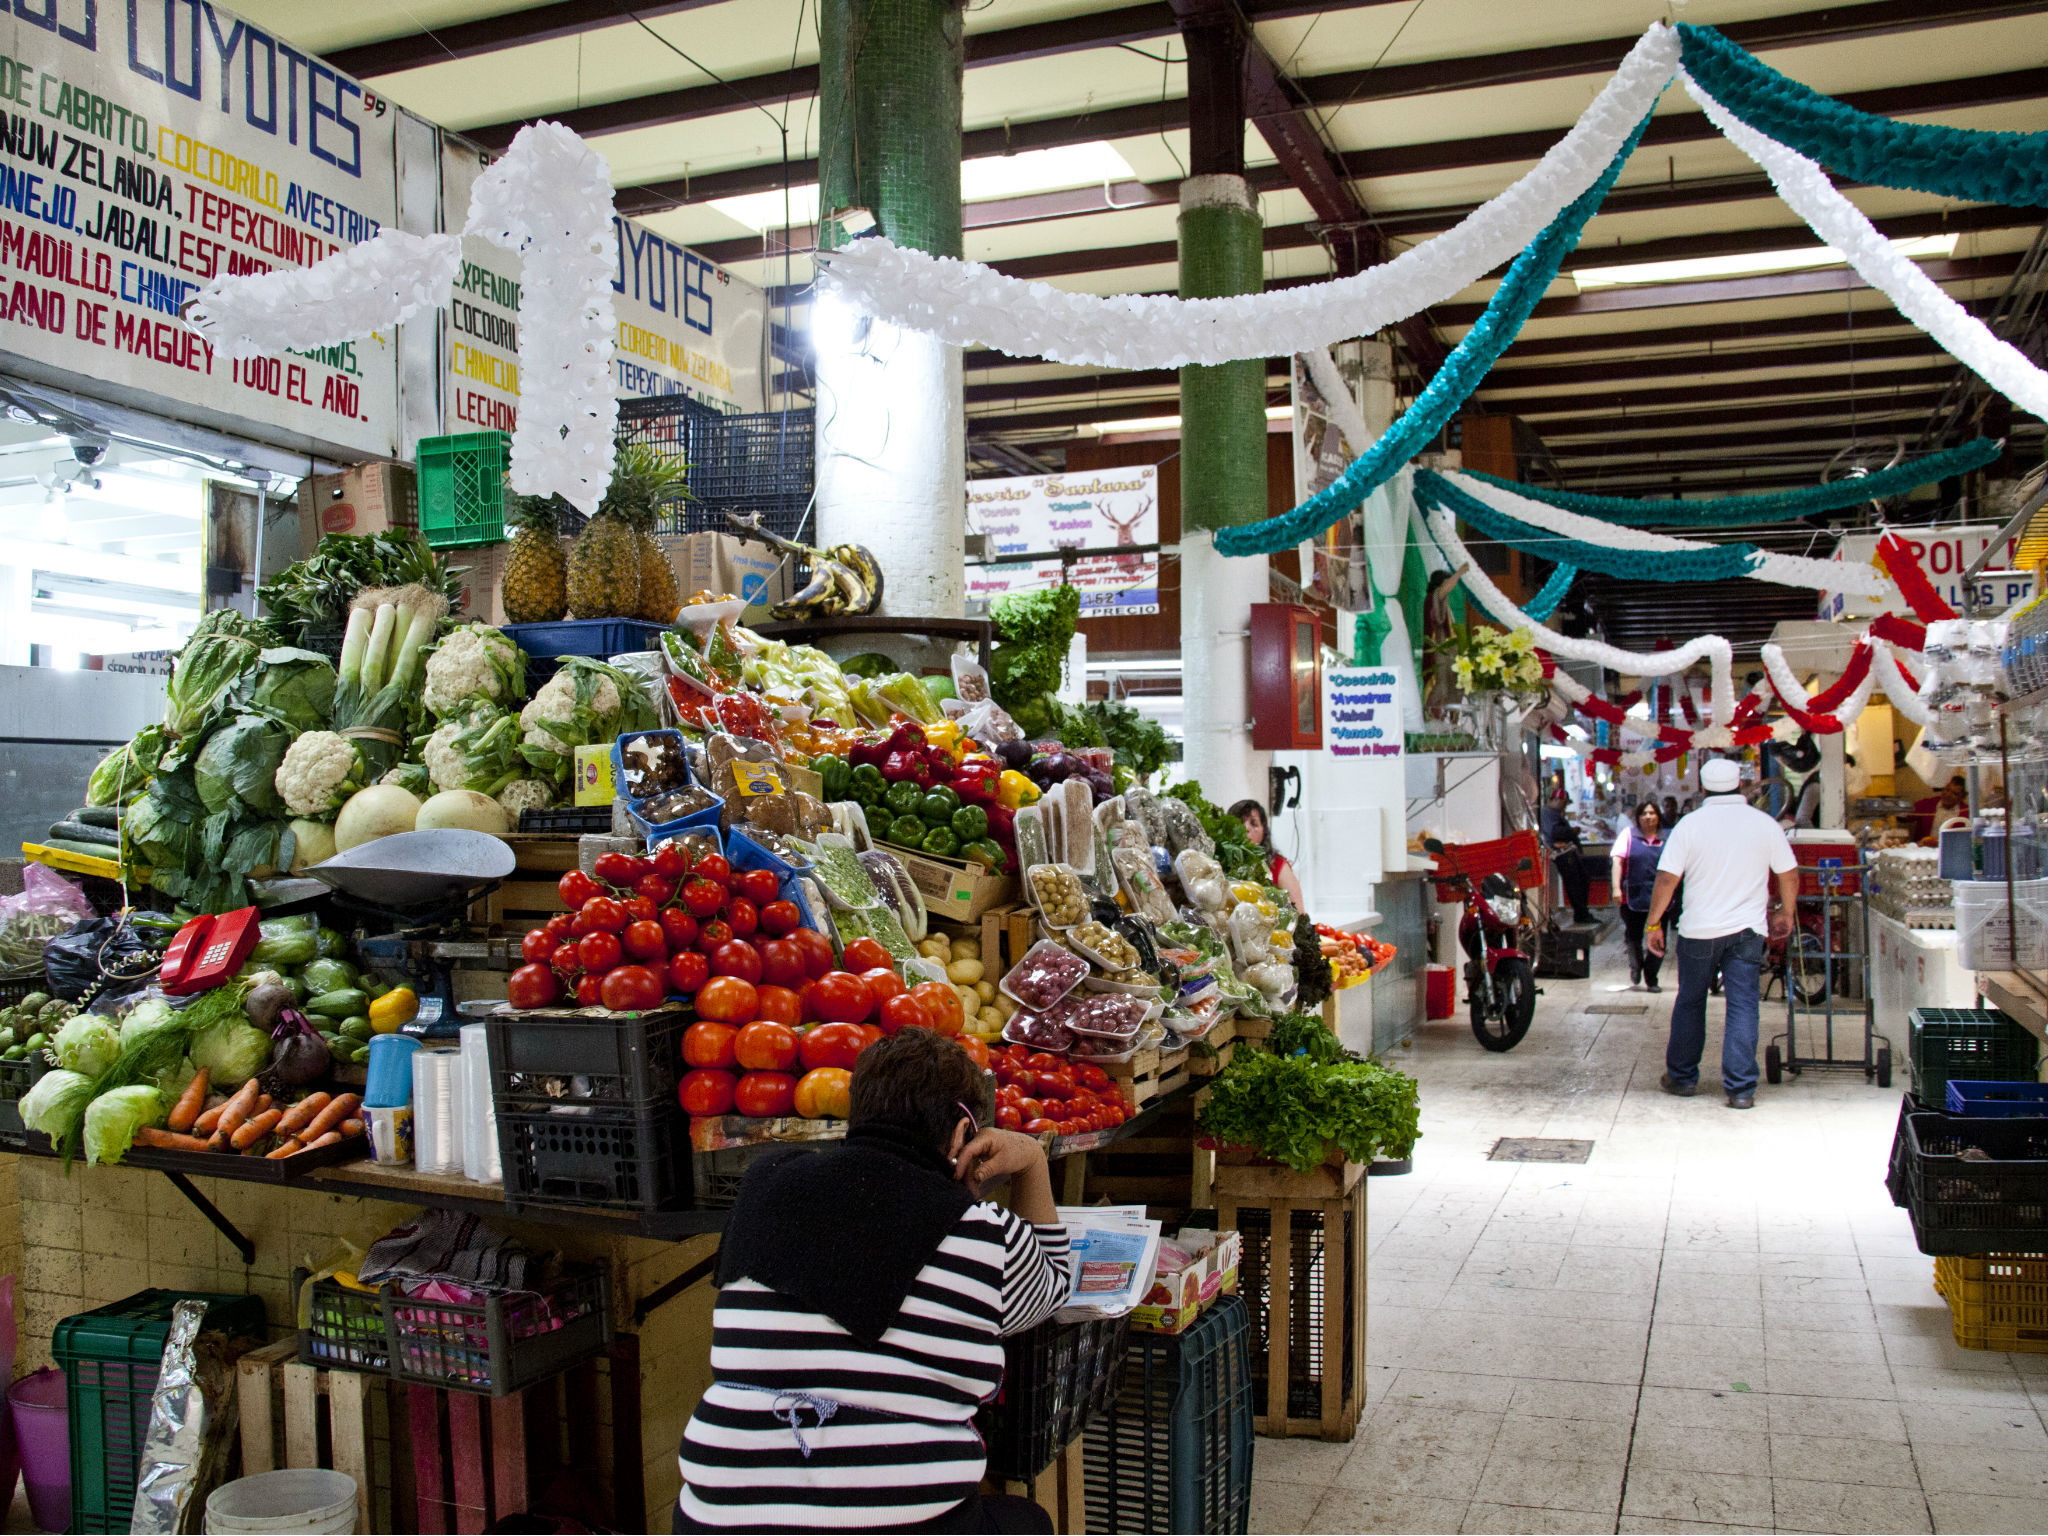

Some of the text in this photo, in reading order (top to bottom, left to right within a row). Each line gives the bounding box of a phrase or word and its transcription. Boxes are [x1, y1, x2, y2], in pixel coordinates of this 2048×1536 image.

[0, 55, 33, 108] DE
[39, 73, 156, 161] CABRITO,
[158, 125, 285, 214] COCODRILO,
[60, 134, 182, 221] ZELANDA,
[0, 218, 117, 300] MADILLO,
[86, 200, 177, 270] JABALI,
[453, 298, 523, 354] COCODRIL
[620, 321, 667, 365] CORDERO
[76, 298, 108, 346] DE
[114, 310, 214, 375] MAGUEY
[287, 363, 313, 406] EL
[323, 374, 369, 422] AÑO.
[453, 341, 522, 396] CHINICUIL
[1092, 605, 1157, 617] PRECIO
[1337, 725, 1384, 740] Venado
